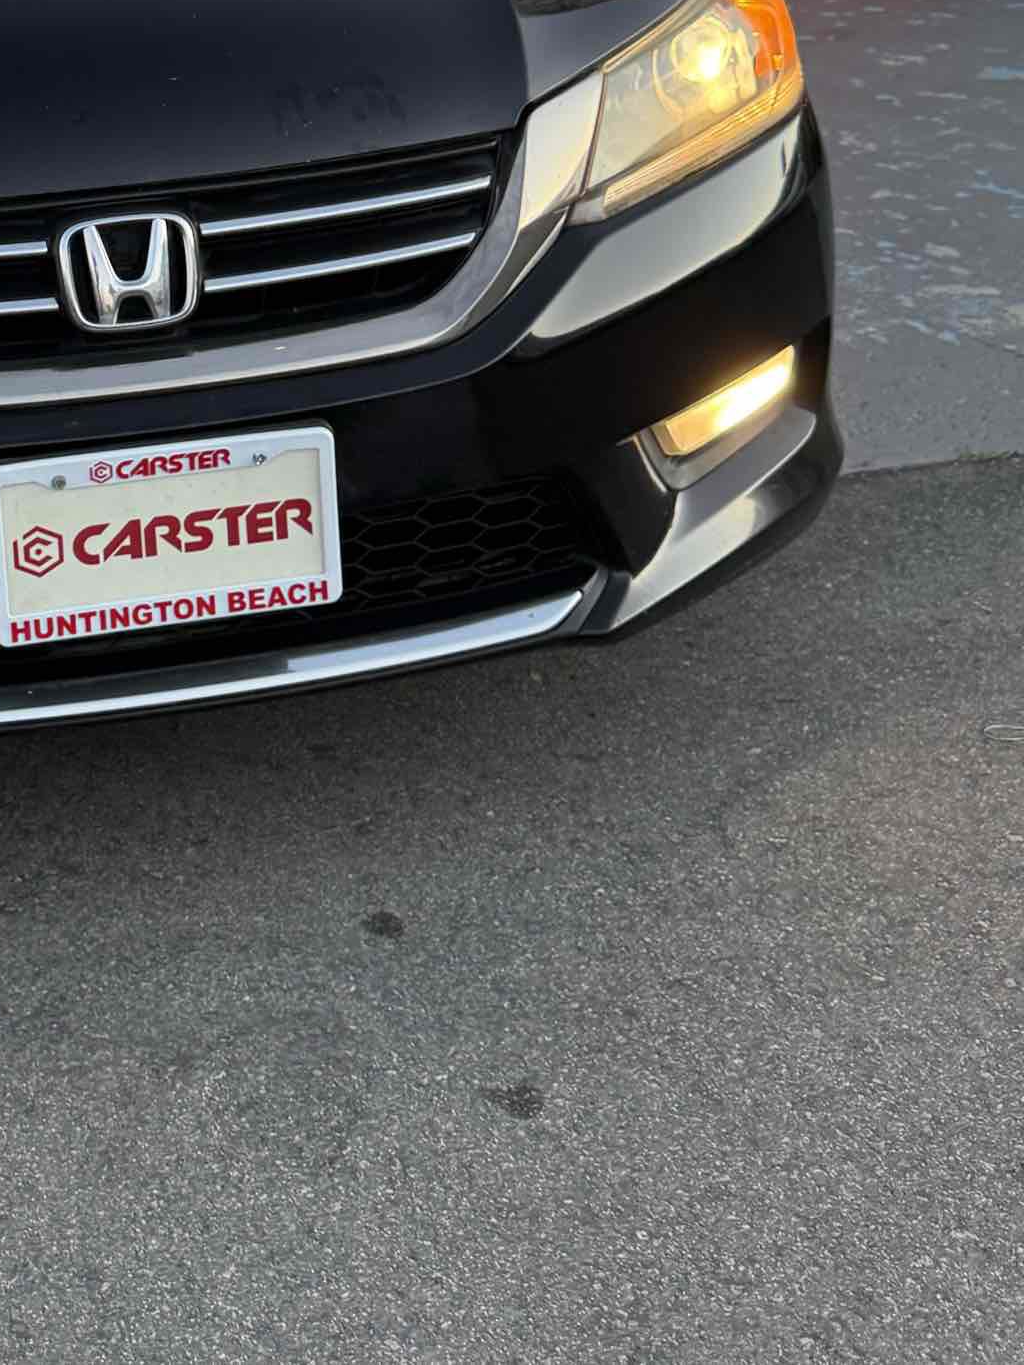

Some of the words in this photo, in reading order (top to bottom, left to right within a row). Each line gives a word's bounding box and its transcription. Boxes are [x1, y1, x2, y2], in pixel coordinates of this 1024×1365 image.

[116, 448, 230, 479] CARSTER
[73, 498, 313, 565] CARSTER
[10, 596, 216, 642] HUNTINGTON
[227, 581, 329, 613] BEACH
